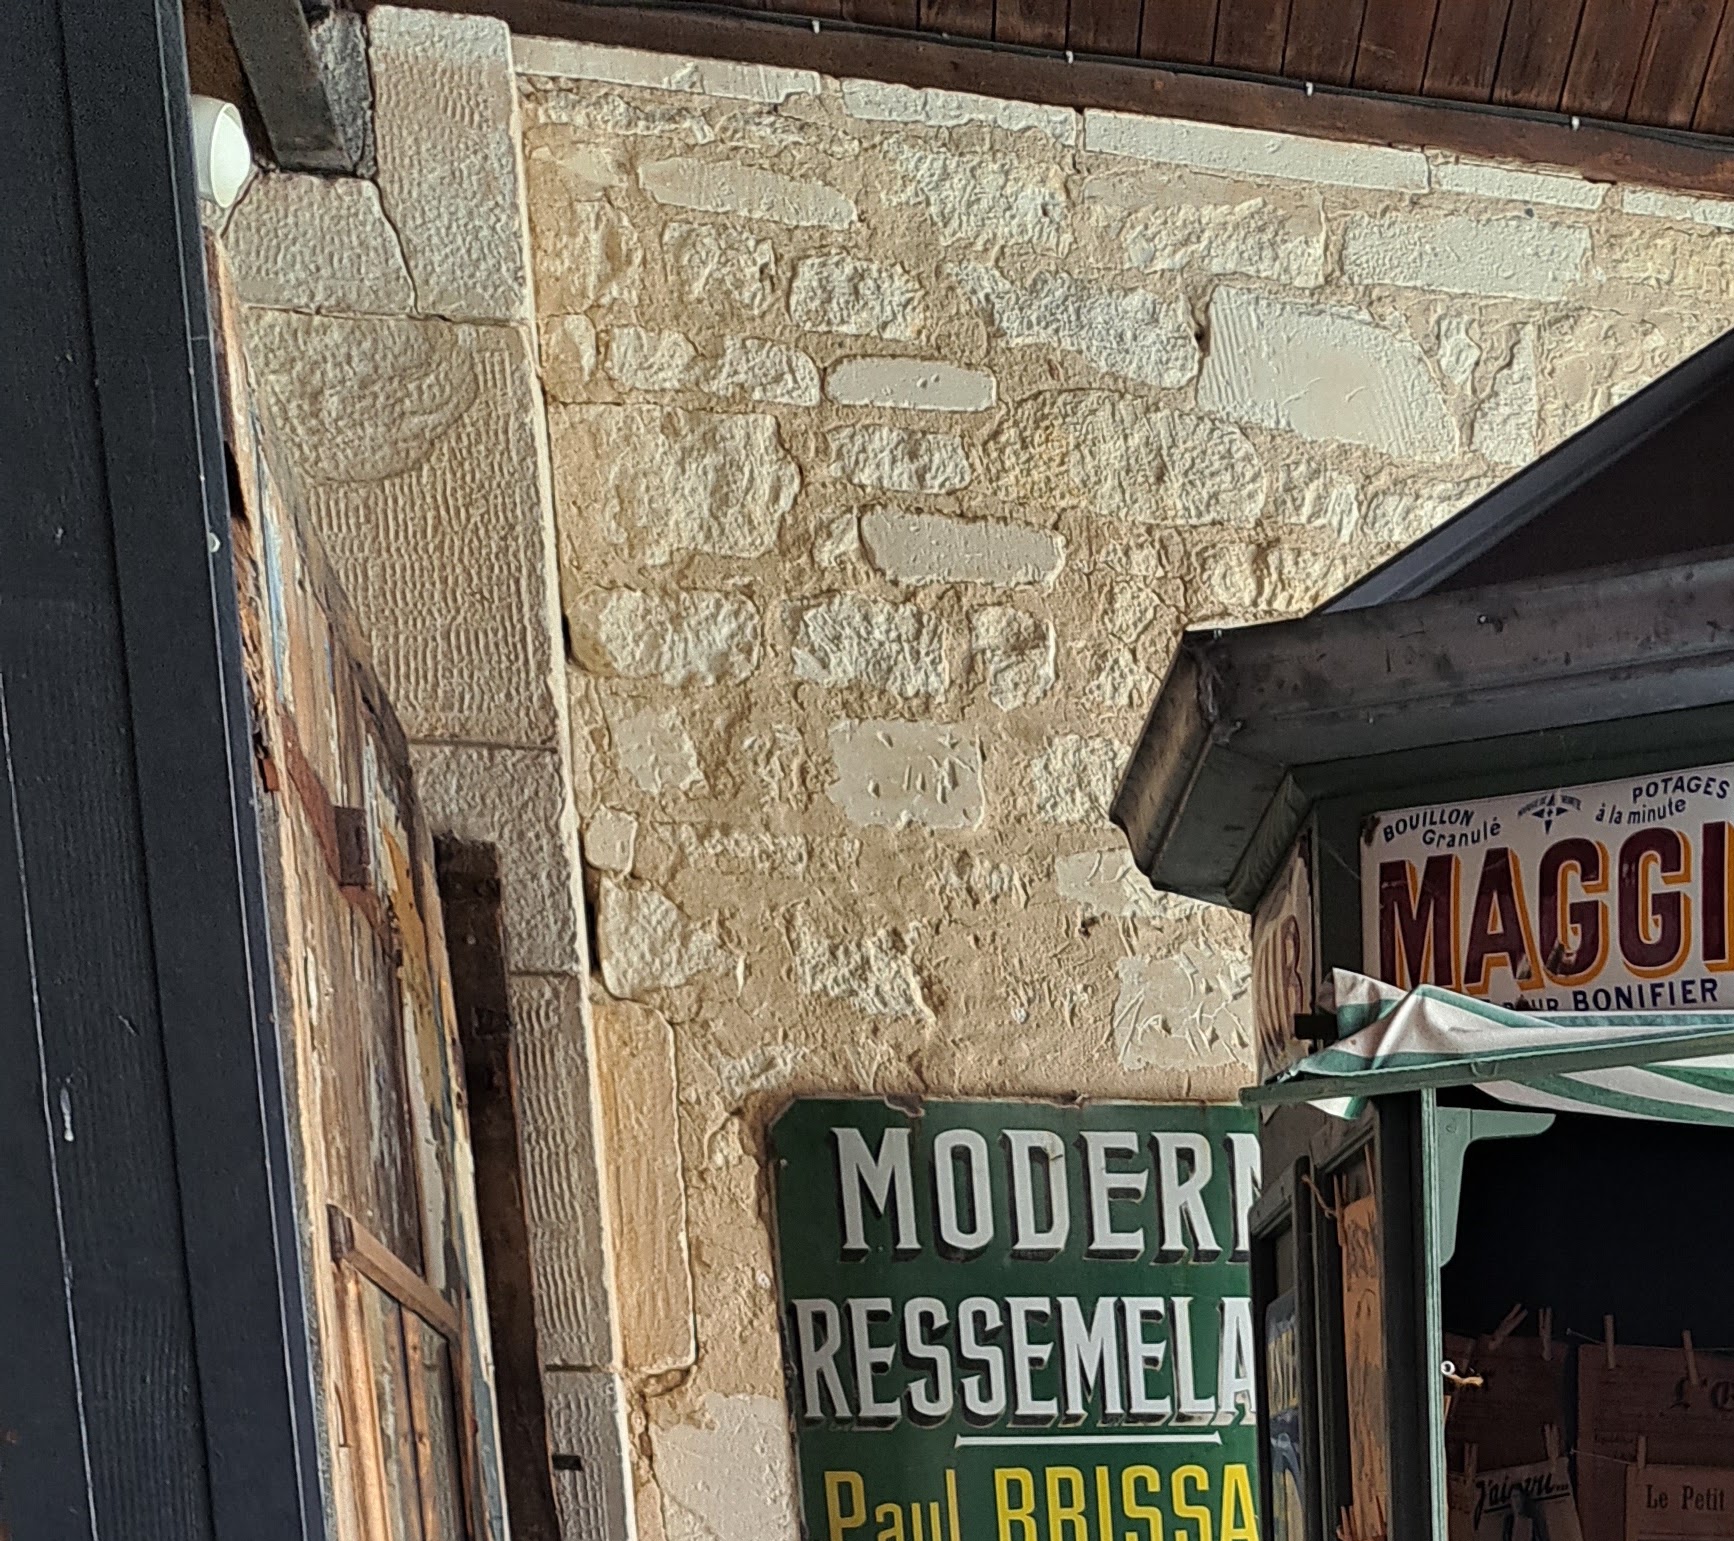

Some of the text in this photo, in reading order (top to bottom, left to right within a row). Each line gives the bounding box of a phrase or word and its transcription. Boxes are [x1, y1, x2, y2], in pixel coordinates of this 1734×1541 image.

[1632, 775, 1730, 803] POTAGES
[1383, 808, 1475, 843] BOUILLON
[1609, 802, 1622, 825] la
[1627, 799, 1687, 825] minute
[1422, 817, 1500, 849] Granulé
[1572, 978, 1717, 1011] BONIFIER
[1645, 1484, 1668, 1509] Le
[1681, 1485, 1725, 1511] Petit
